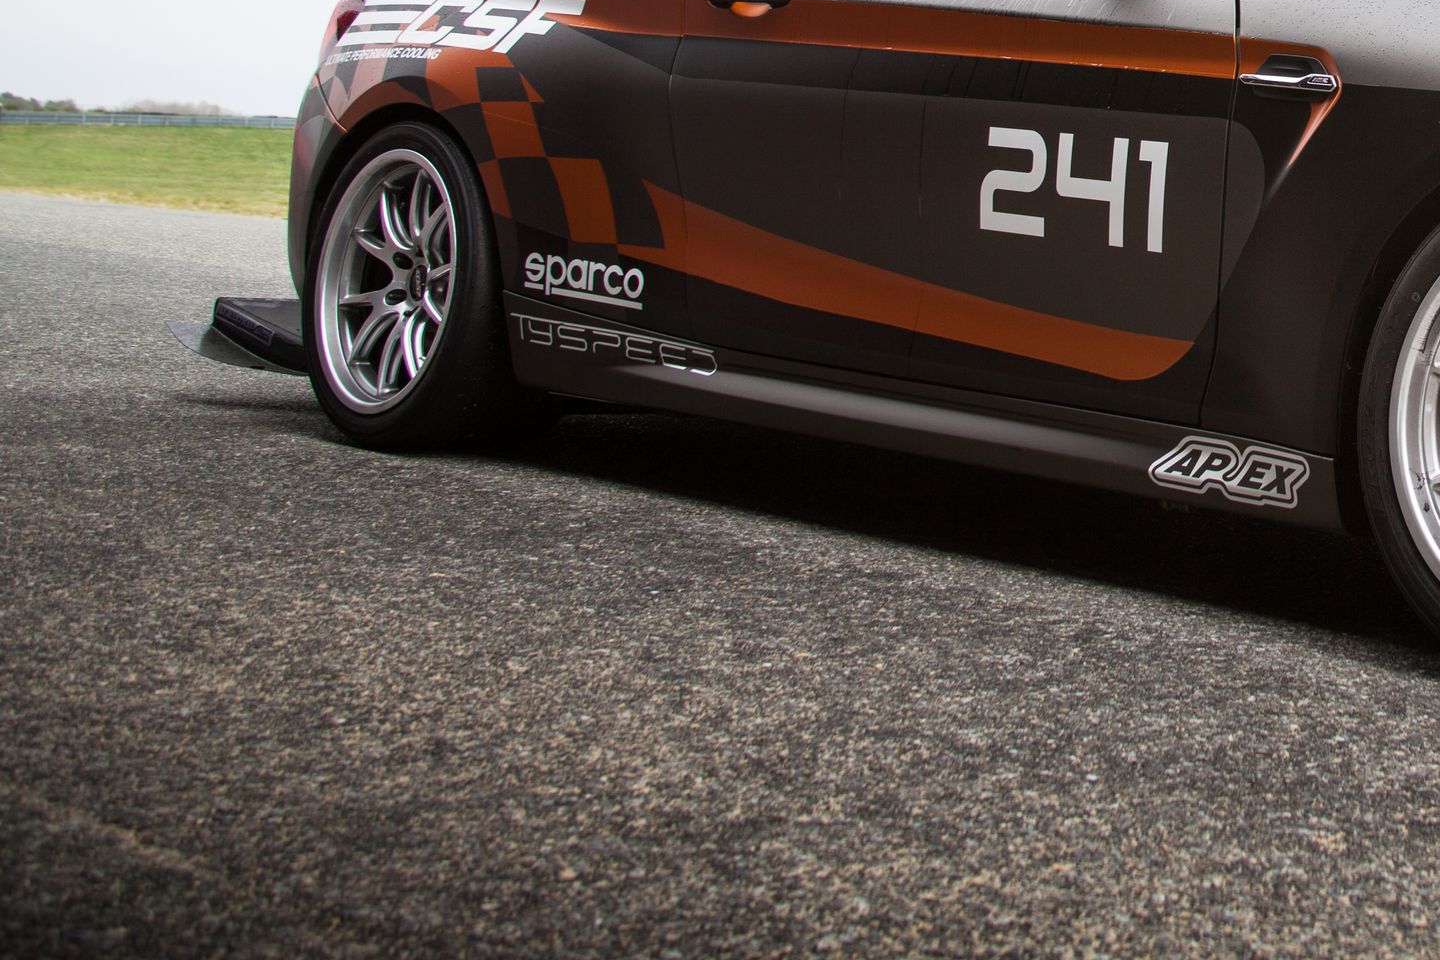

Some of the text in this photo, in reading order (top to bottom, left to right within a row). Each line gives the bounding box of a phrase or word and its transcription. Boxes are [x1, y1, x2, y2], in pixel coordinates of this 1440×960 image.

[401, 47, 442, 60] COOLING
[979, 126, 1169, 254] 241
[524, 251, 645, 300] sparco
[1160, 446, 1299, 498] APEX
